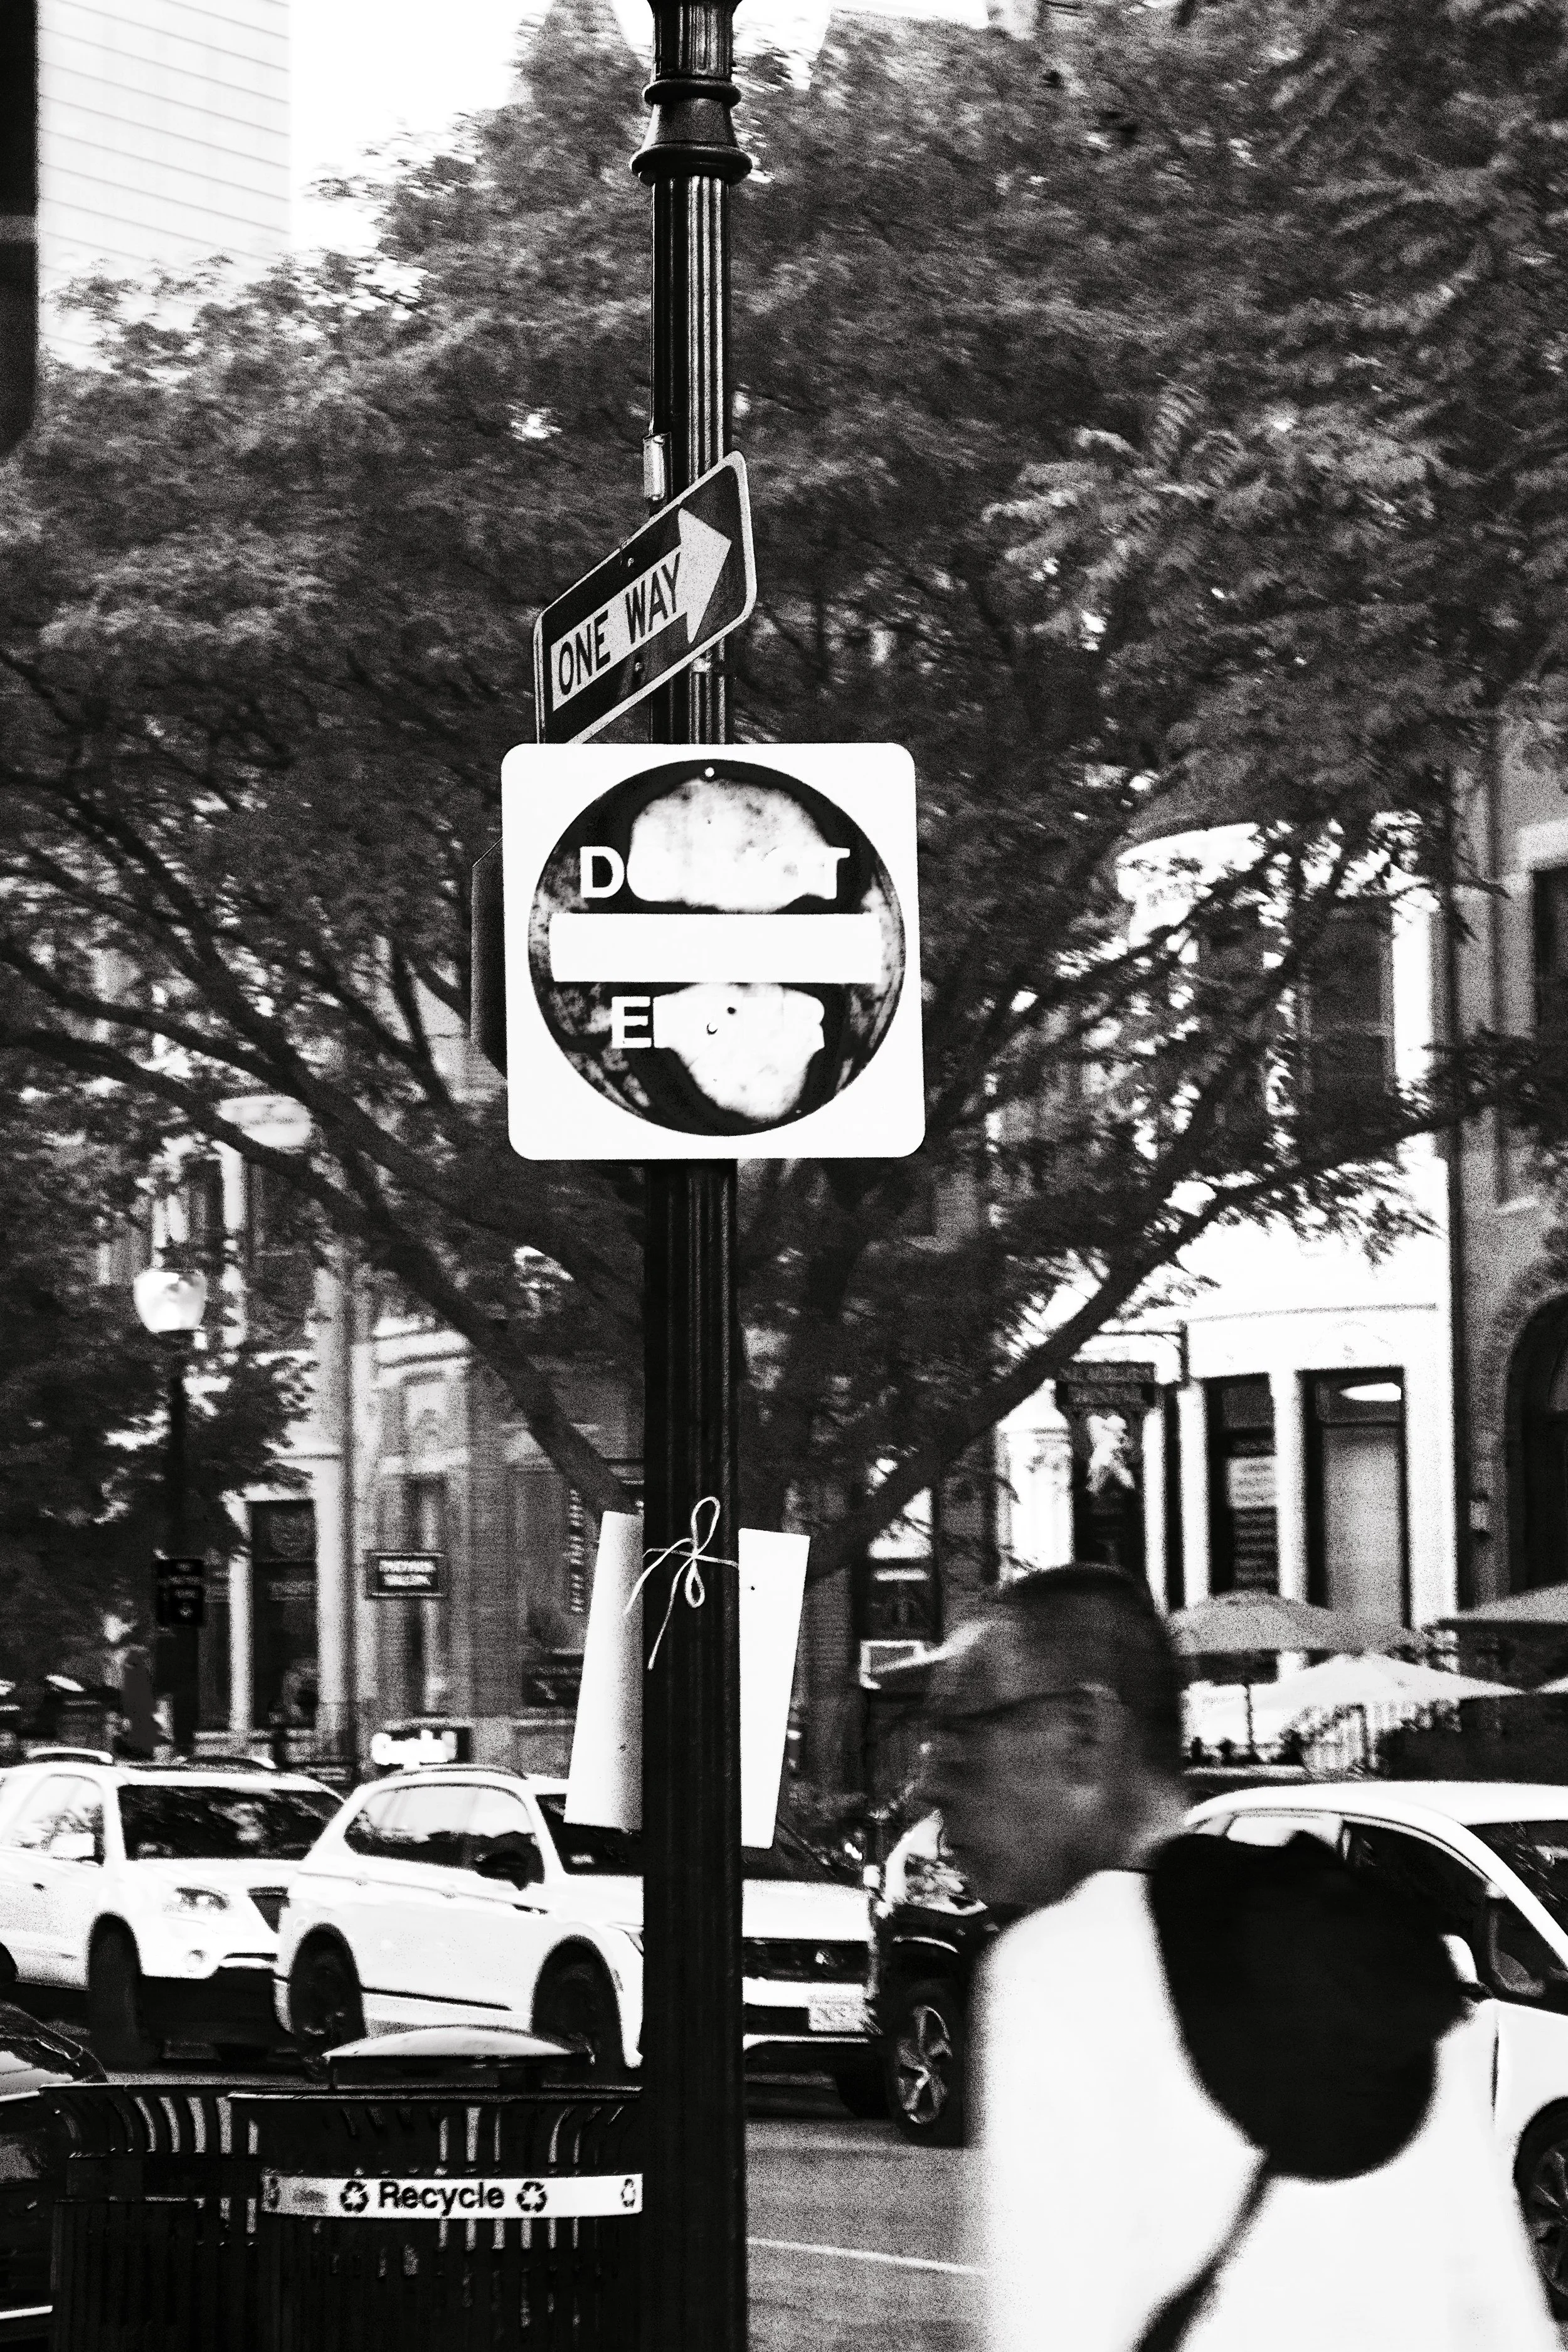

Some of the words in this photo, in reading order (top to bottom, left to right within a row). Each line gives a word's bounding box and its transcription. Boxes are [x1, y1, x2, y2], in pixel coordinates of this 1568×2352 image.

[558, 610, 611, 696] ONE
[625, 551, 681, 647] WAY
[378, 2181, 506, 2217] Recycle
